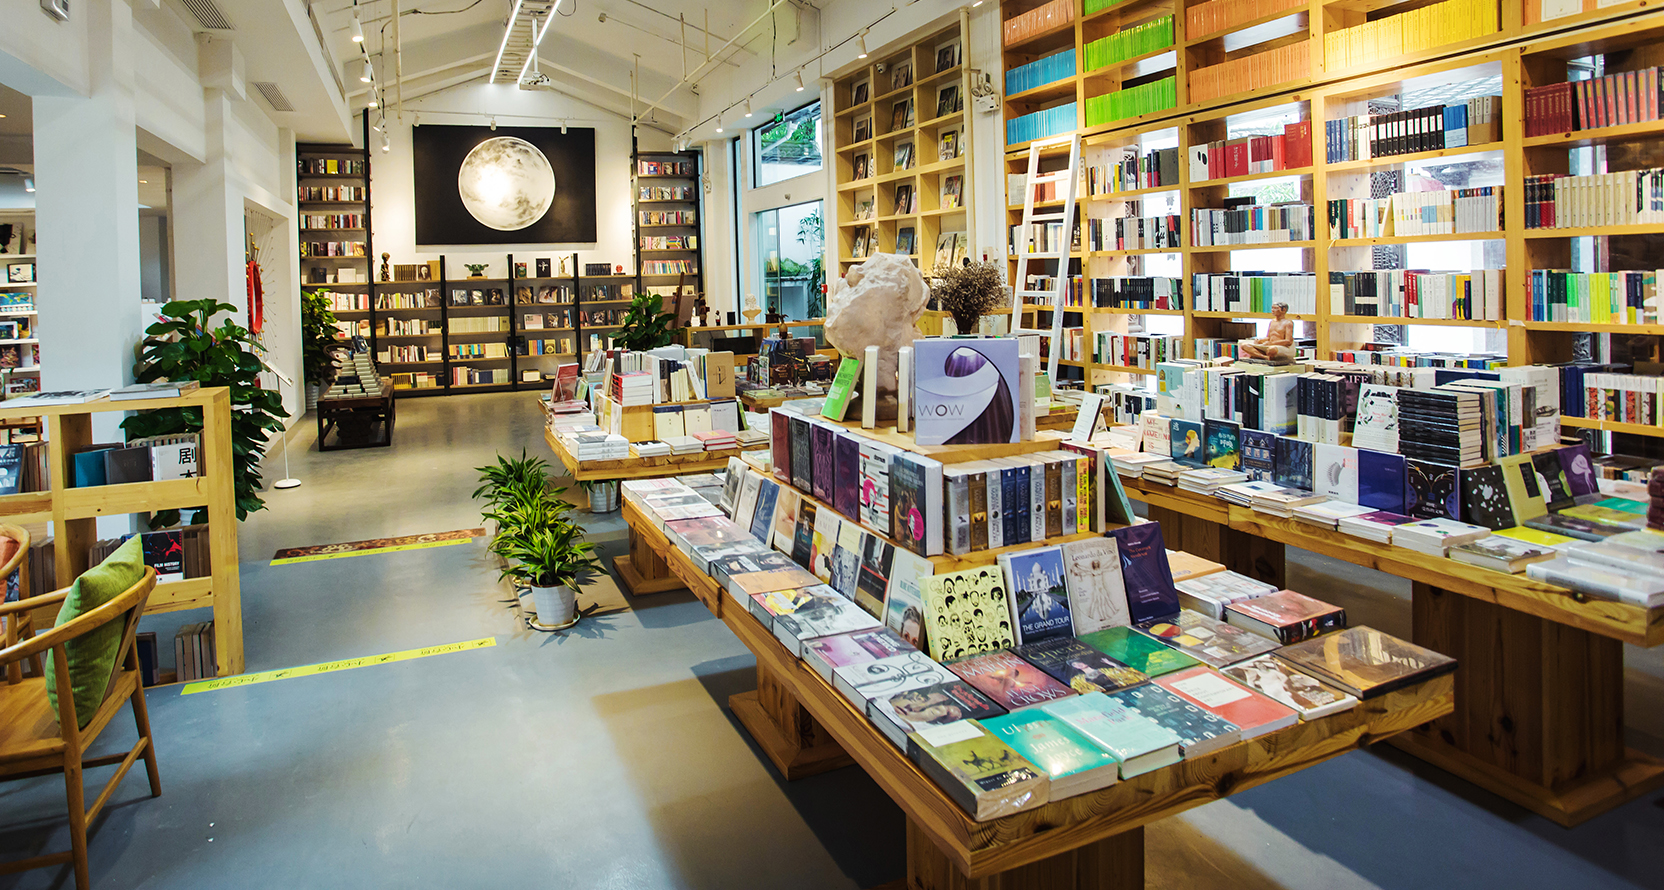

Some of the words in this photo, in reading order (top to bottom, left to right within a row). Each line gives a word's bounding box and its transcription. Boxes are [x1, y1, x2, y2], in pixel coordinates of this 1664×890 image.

[918, 404, 964, 417] WOW
[1033, 620, 1053, 630] GRAND
[1054, 616, 1069, 627] TOUR
[961, 657, 1026, 678] MARTIN
[1010, 688, 1067, 706] CROWS
[1075, 706, 1127, 725] Mansfield
[1107, 714, 1133, 725] Park
[1029, 736, 1071, 754] James
[1045, 747, 1083, 763] Joyce
